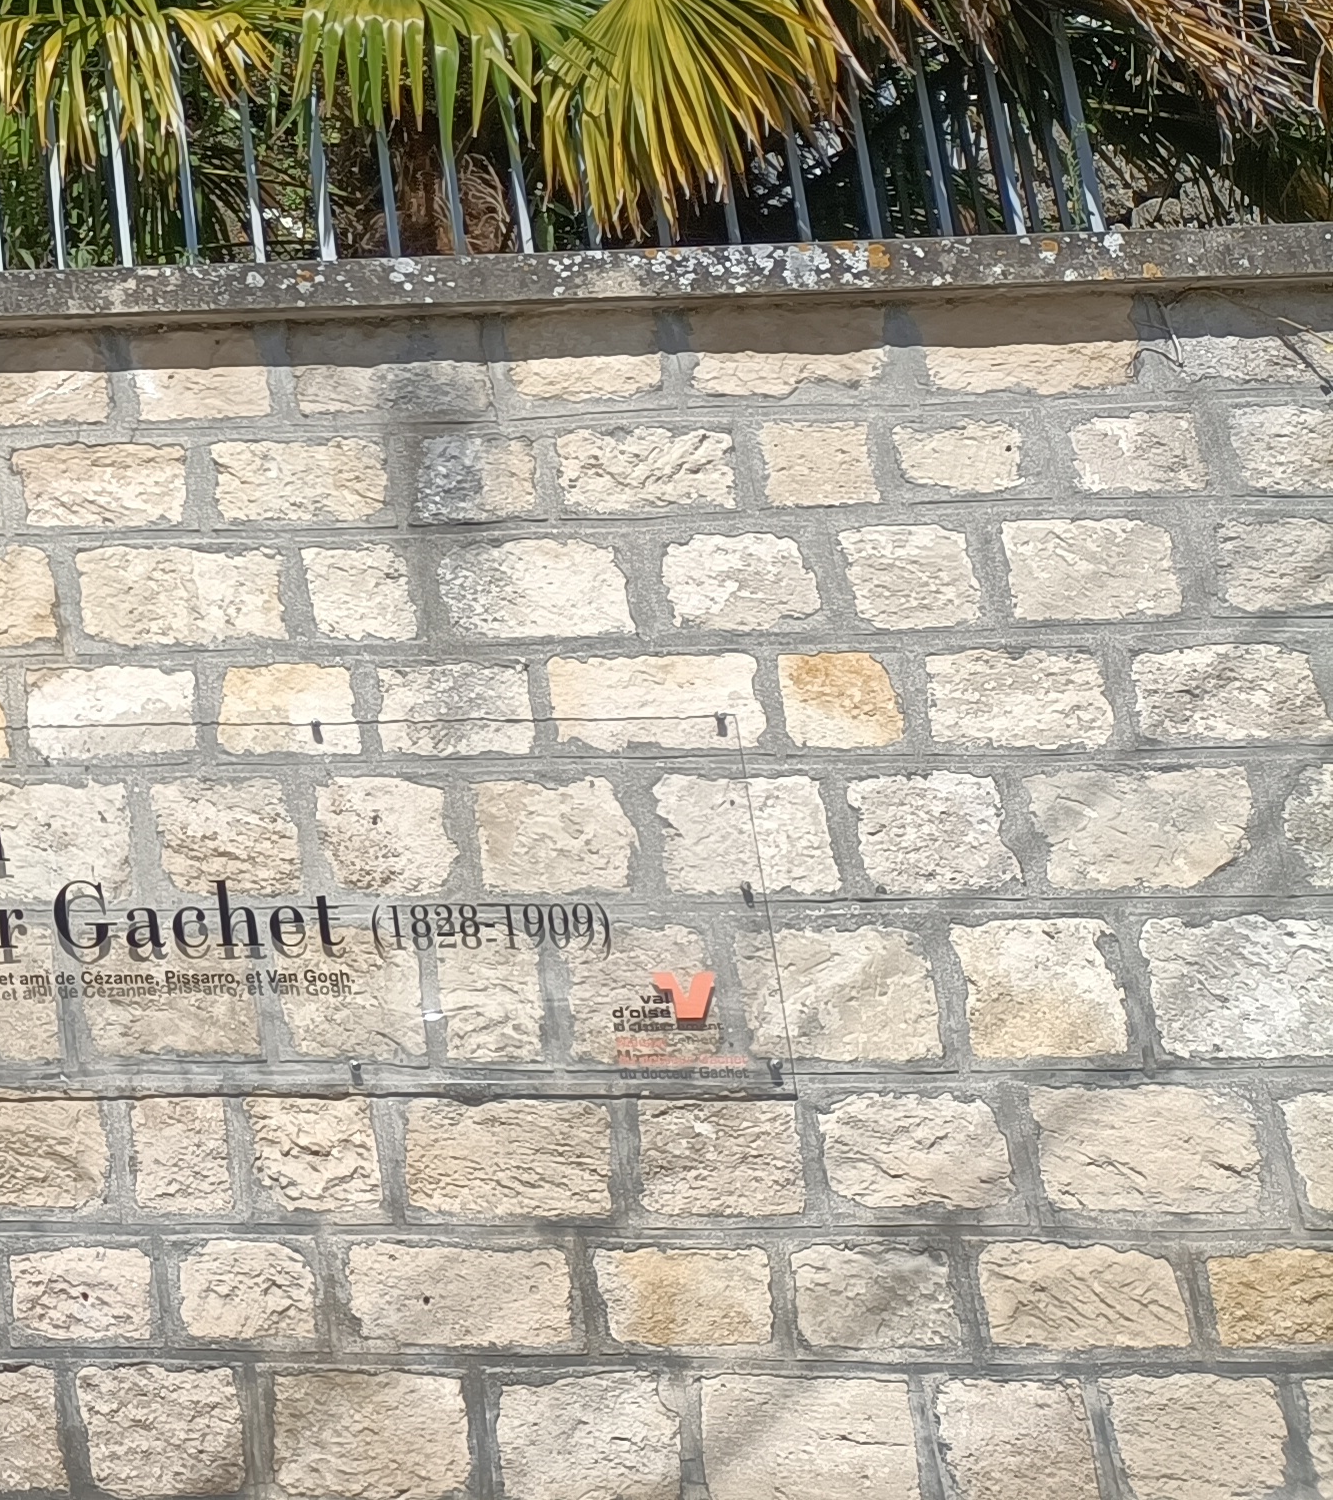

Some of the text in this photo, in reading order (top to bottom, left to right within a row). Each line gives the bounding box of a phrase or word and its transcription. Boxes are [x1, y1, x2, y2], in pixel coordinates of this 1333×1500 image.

[53, 879, 347, 950] Gachet
[370, 901, 611, 949] (1828-1909)
[19, 972, 51, 986] ami
[54, 971, 76, 986] de
[80, 970, 160, 988] Cézanne,
[165, 970, 241, 988] Pissarro,
[245, 970, 263, 985] et
[266, 969, 299, 985] Van
[303, 969, 356, 987] Gogh.
[639, 992, 671, 1004] val
